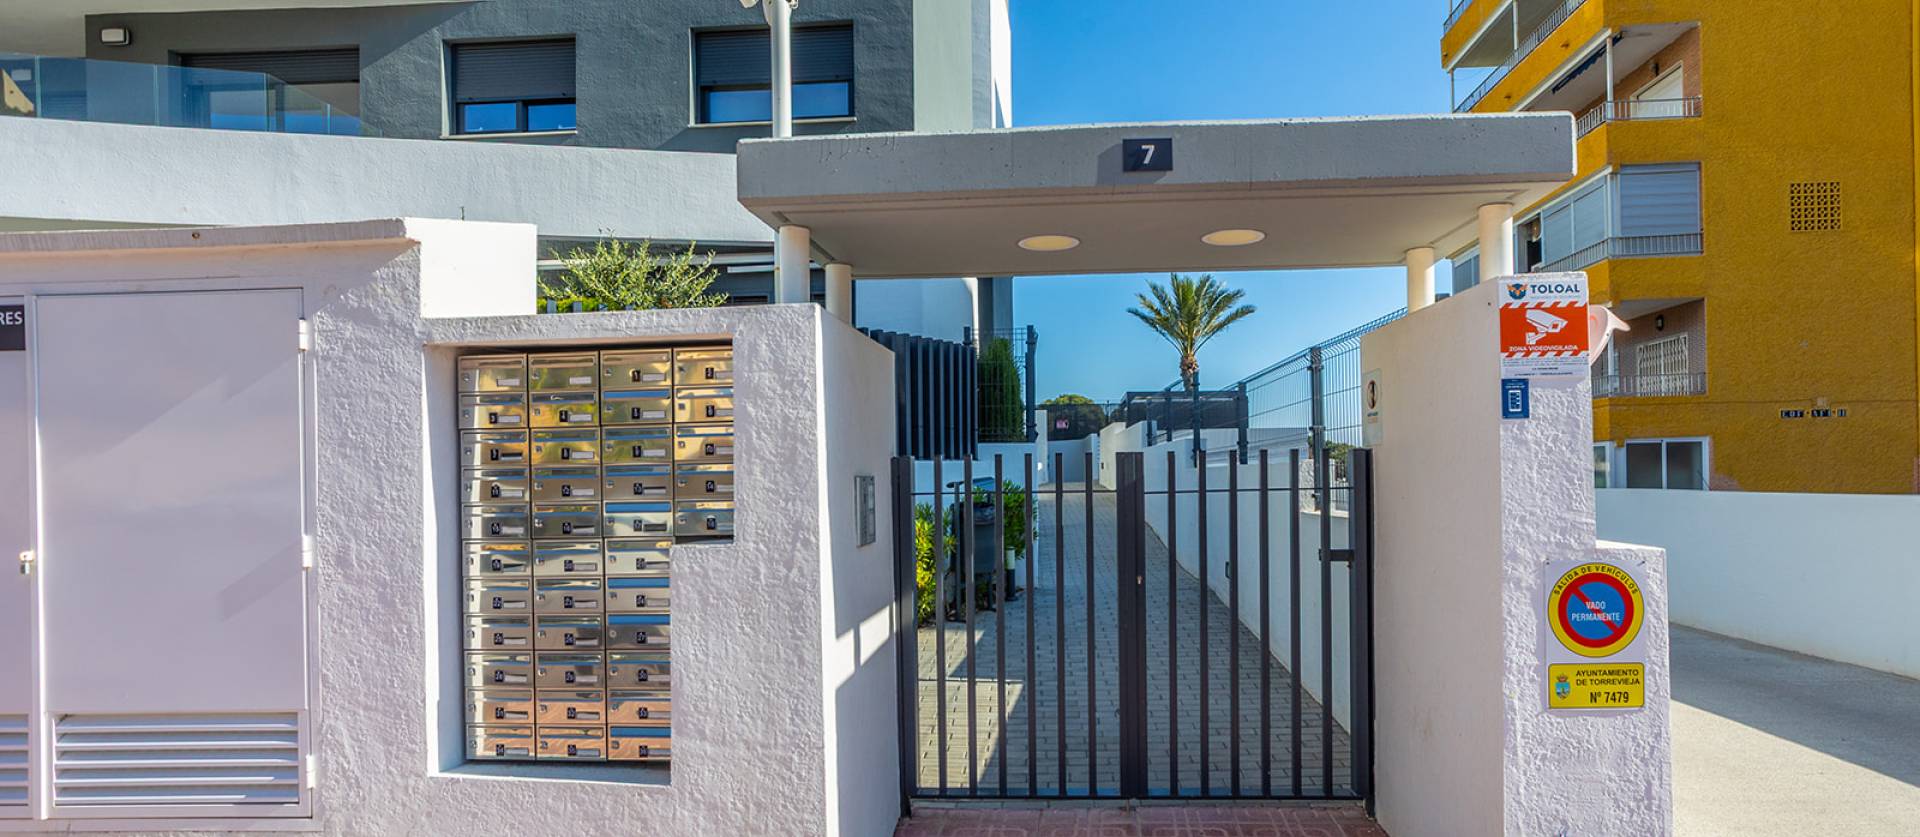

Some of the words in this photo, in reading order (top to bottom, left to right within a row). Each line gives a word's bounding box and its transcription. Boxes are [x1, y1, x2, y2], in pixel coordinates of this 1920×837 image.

[1141, 144, 1155, 164] 7
[1530, 283, 1580, 294] TOLOAL
[1554, 570, 1580, 595] SALIDA
[1581, 565, 1593, 574] DE
[1585, 601, 1606, 610] VADO
[1571, 612, 1621, 622] PERMANENTE
[1575, 669, 1639, 677] AYUNTAMIENTO
[1576, 678, 1588, 686] DE
[1590, 677, 1640, 686] TORREVIEJA
[1605, 691, 1630, 703] 7479
